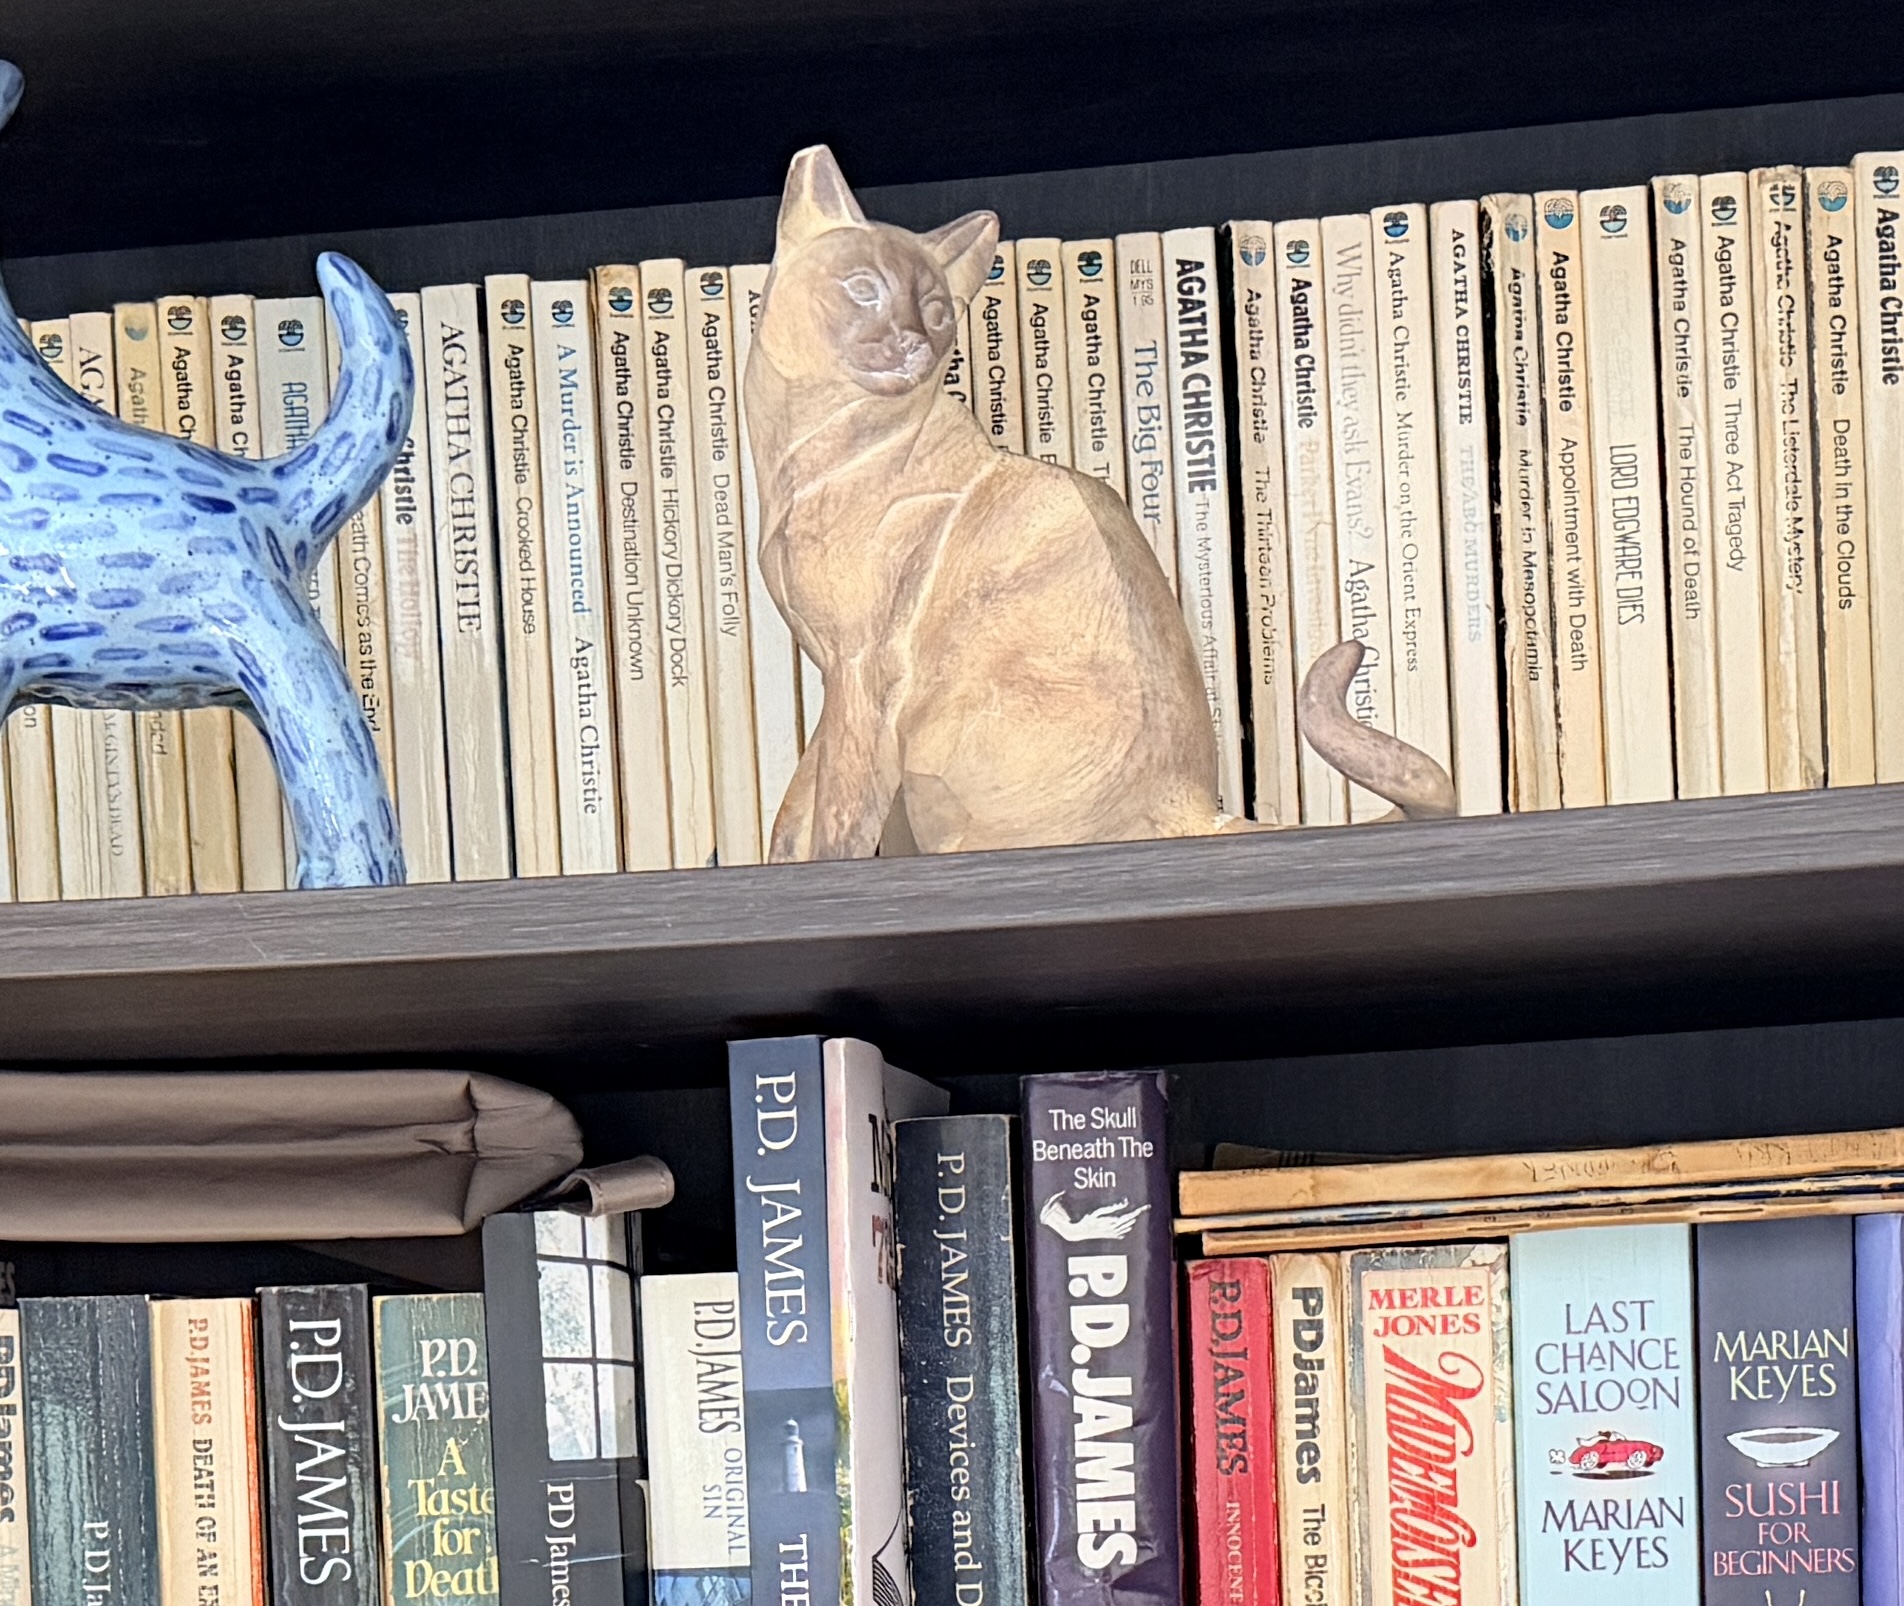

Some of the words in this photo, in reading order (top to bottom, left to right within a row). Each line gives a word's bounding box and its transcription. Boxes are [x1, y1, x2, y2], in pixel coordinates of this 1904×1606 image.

[1176, 259, 1210, 369] AGATHA
[1133, 340, 1160, 398] The
[441, 321, 472, 463] AGATHA
[1132, 403, 1161, 457] Big
[1183, 373, 1217, 493] CHRISTIE
[1610, 444, 1638, 488] LORD
[1140, 461, 1162, 526] Four
[449, 468, 482, 636] CHRISTIE
[1612, 495, 1641, 581] EDGWARE
[1616, 586, 1644, 626] DIES
[755, 1072, 798, 1155] P.D.
[1049, 1109, 1086, 1131] The
[1091, 1107, 1137, 1130] Skull
[1033, 1139, 1115, 1162] Beneath
[1119, 1137, 1153, 1158] The
[1073, 1167, 1116, 1189] Skin
[746, 1177, 807, 1347] JAMES
[1369, 1284, 1485, 1310] MERLE
[1373, 1313, 1481, 1338] JONES
[1565, 1300, 1654, 1334] LAST
[1536, 1339, 1680, 1375] CHANCE
[1714, 1328, 1849, 1362] MARIAN
[1536, 1376, 1680, 1415] SALOON
[1730, 1364, 1837, 1403] KEYES
[547, 1483, 574, 1528] PD
[1542, 1496, 1685, 1532] MARIAN
[1725, 1480, 1840, 1518] SUSHI
[1758, 1523, 1811, 1545] FOR
[1564, 1536, 1669, 1574] KEYES
[1713, 1548, 1855, 1577] BEGINNERS
